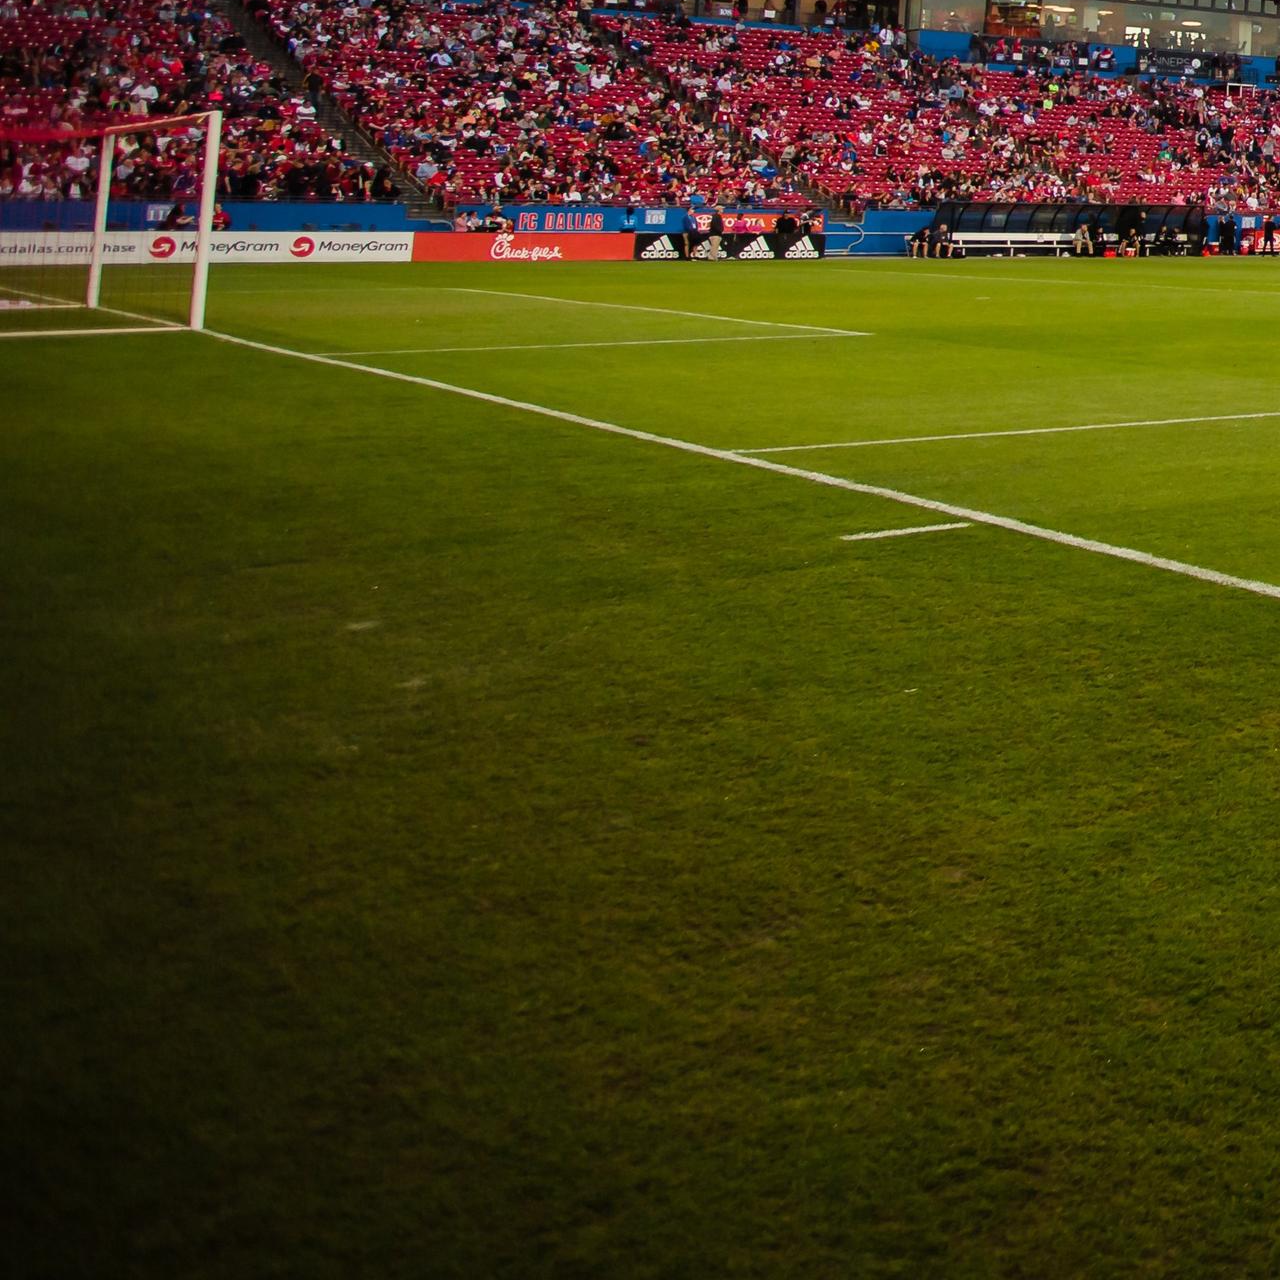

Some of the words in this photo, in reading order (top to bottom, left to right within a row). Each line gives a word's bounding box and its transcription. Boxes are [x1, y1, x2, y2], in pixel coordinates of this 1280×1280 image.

[519, 213, 537, 231] FC
[545, 213, 603, 231] DALLAS
[319, 240, 408, 254] MoneyGram
[641, 249, 679, 259] adidas
[739, 250, 775, 259] adidas
[785, 250, 819, 259] adidas
